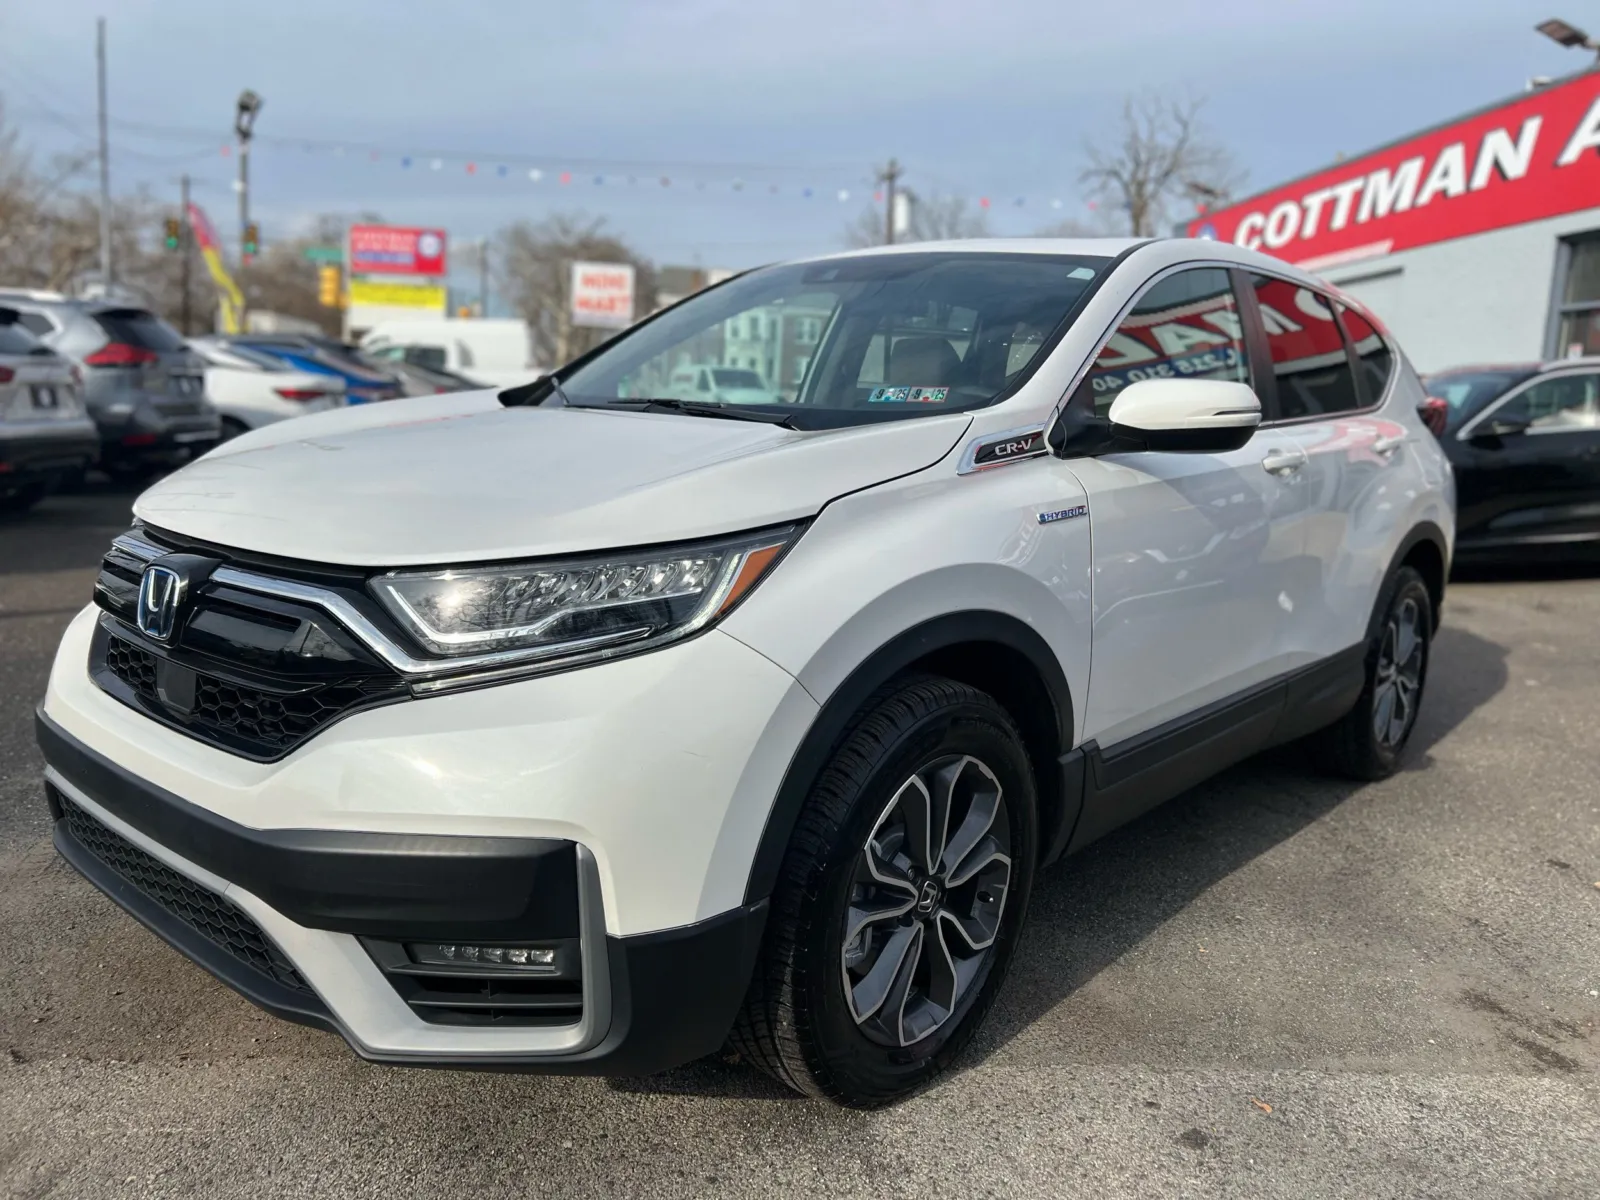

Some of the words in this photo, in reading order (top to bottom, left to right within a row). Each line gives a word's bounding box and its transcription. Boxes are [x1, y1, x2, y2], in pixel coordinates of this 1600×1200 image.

[1233, 114, 1543, 251] COTTMAN
[994, 438, 1033, 456] CR-V
[1046, 506, 1085, 520] HYBRID
